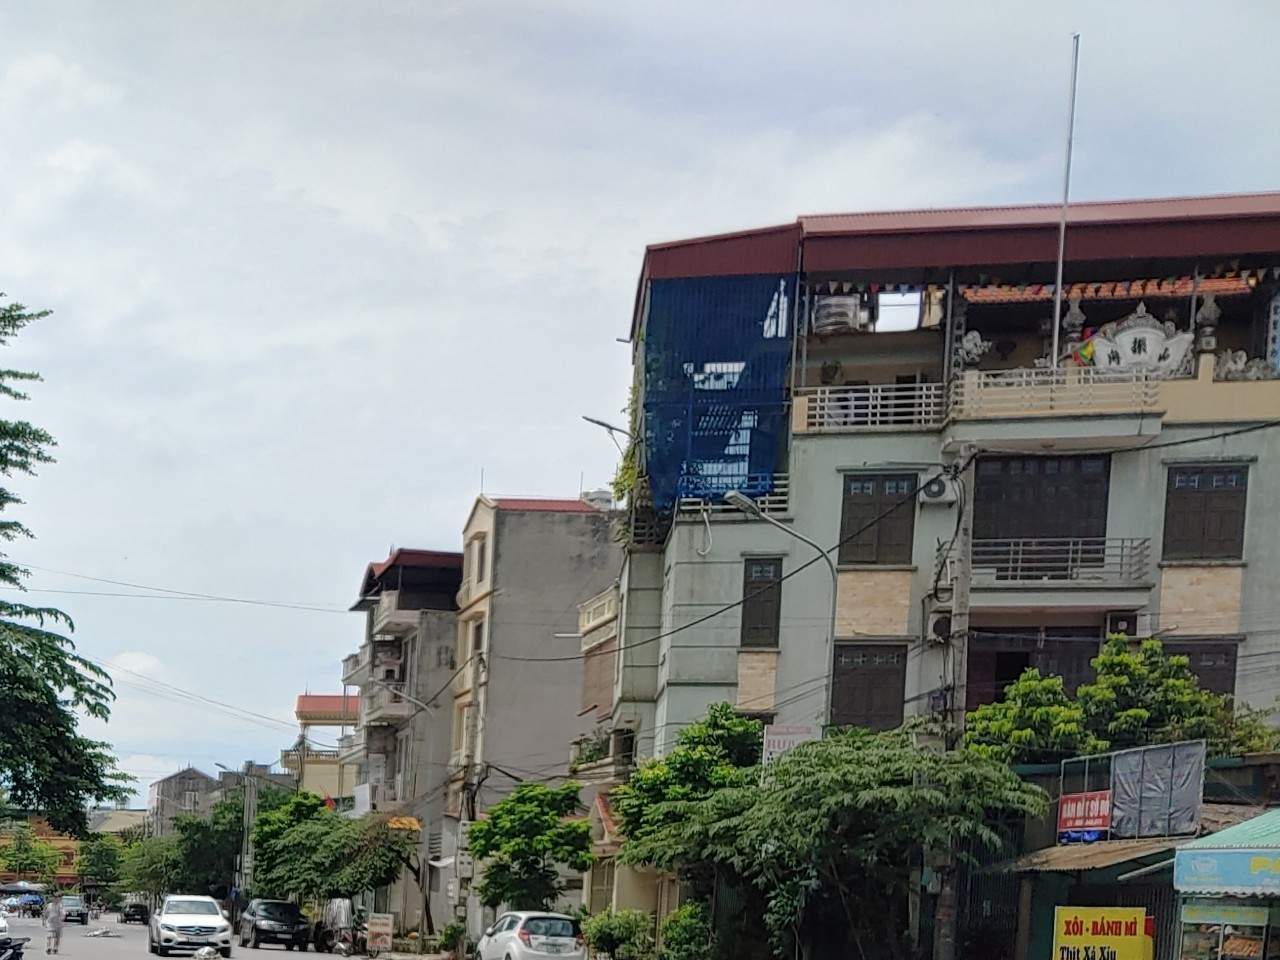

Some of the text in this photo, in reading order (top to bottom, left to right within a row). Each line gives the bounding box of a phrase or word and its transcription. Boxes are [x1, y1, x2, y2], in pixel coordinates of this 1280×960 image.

[1063, 915, 1084, 936] XÔI
[1091, 916, 1122, 937] BÁNH
[1124, 916, 1137, 936] MÌ
[1099, 946, 1116, 960] Xíu
